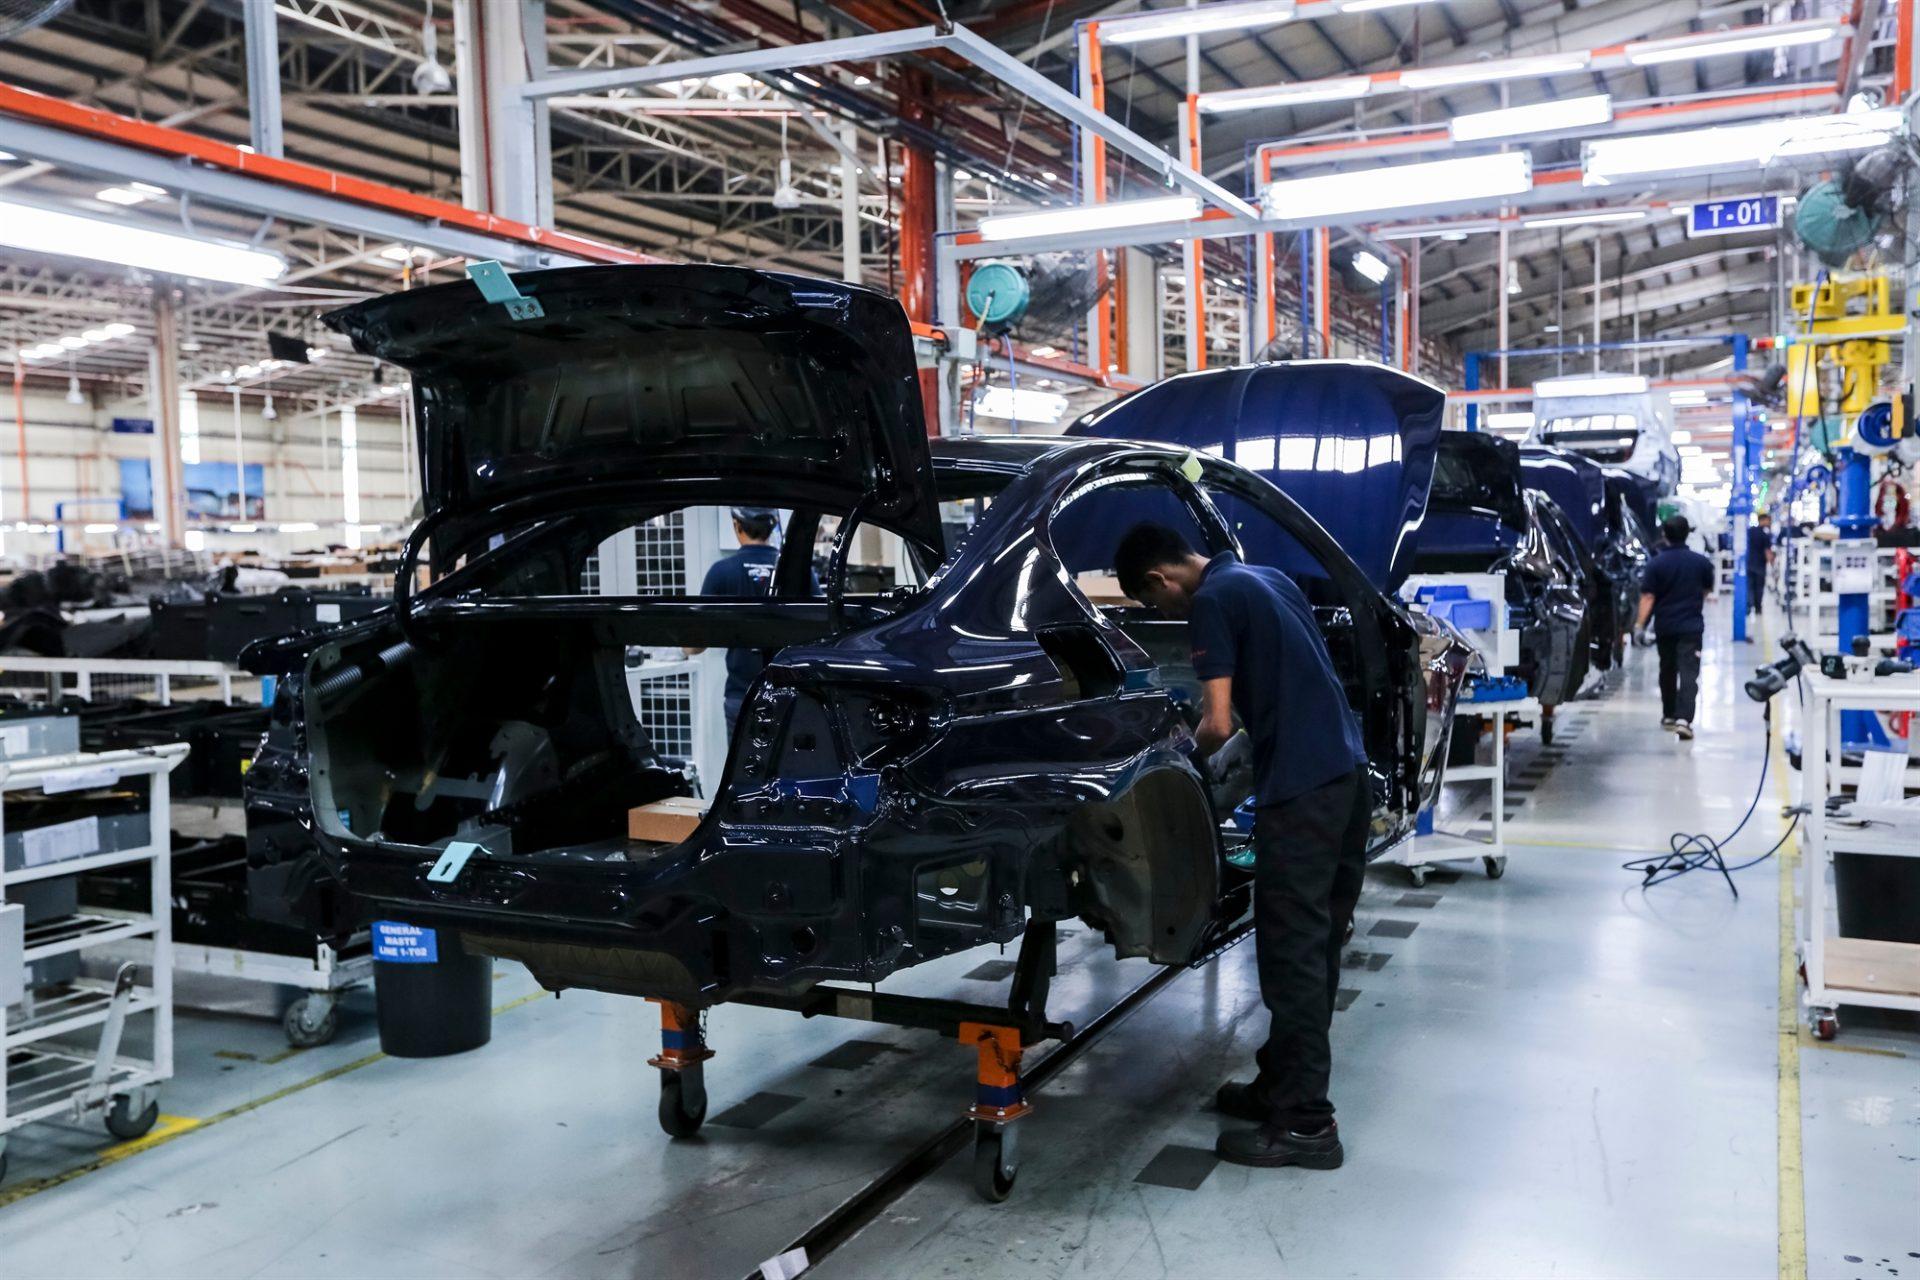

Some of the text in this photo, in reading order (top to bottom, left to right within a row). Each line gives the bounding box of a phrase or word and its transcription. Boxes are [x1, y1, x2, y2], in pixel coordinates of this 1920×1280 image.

[380, 925, 423, 935] GENERAL
[384, 937, 417, 946] WASTE
[379, 946, 398, 956] LINE
